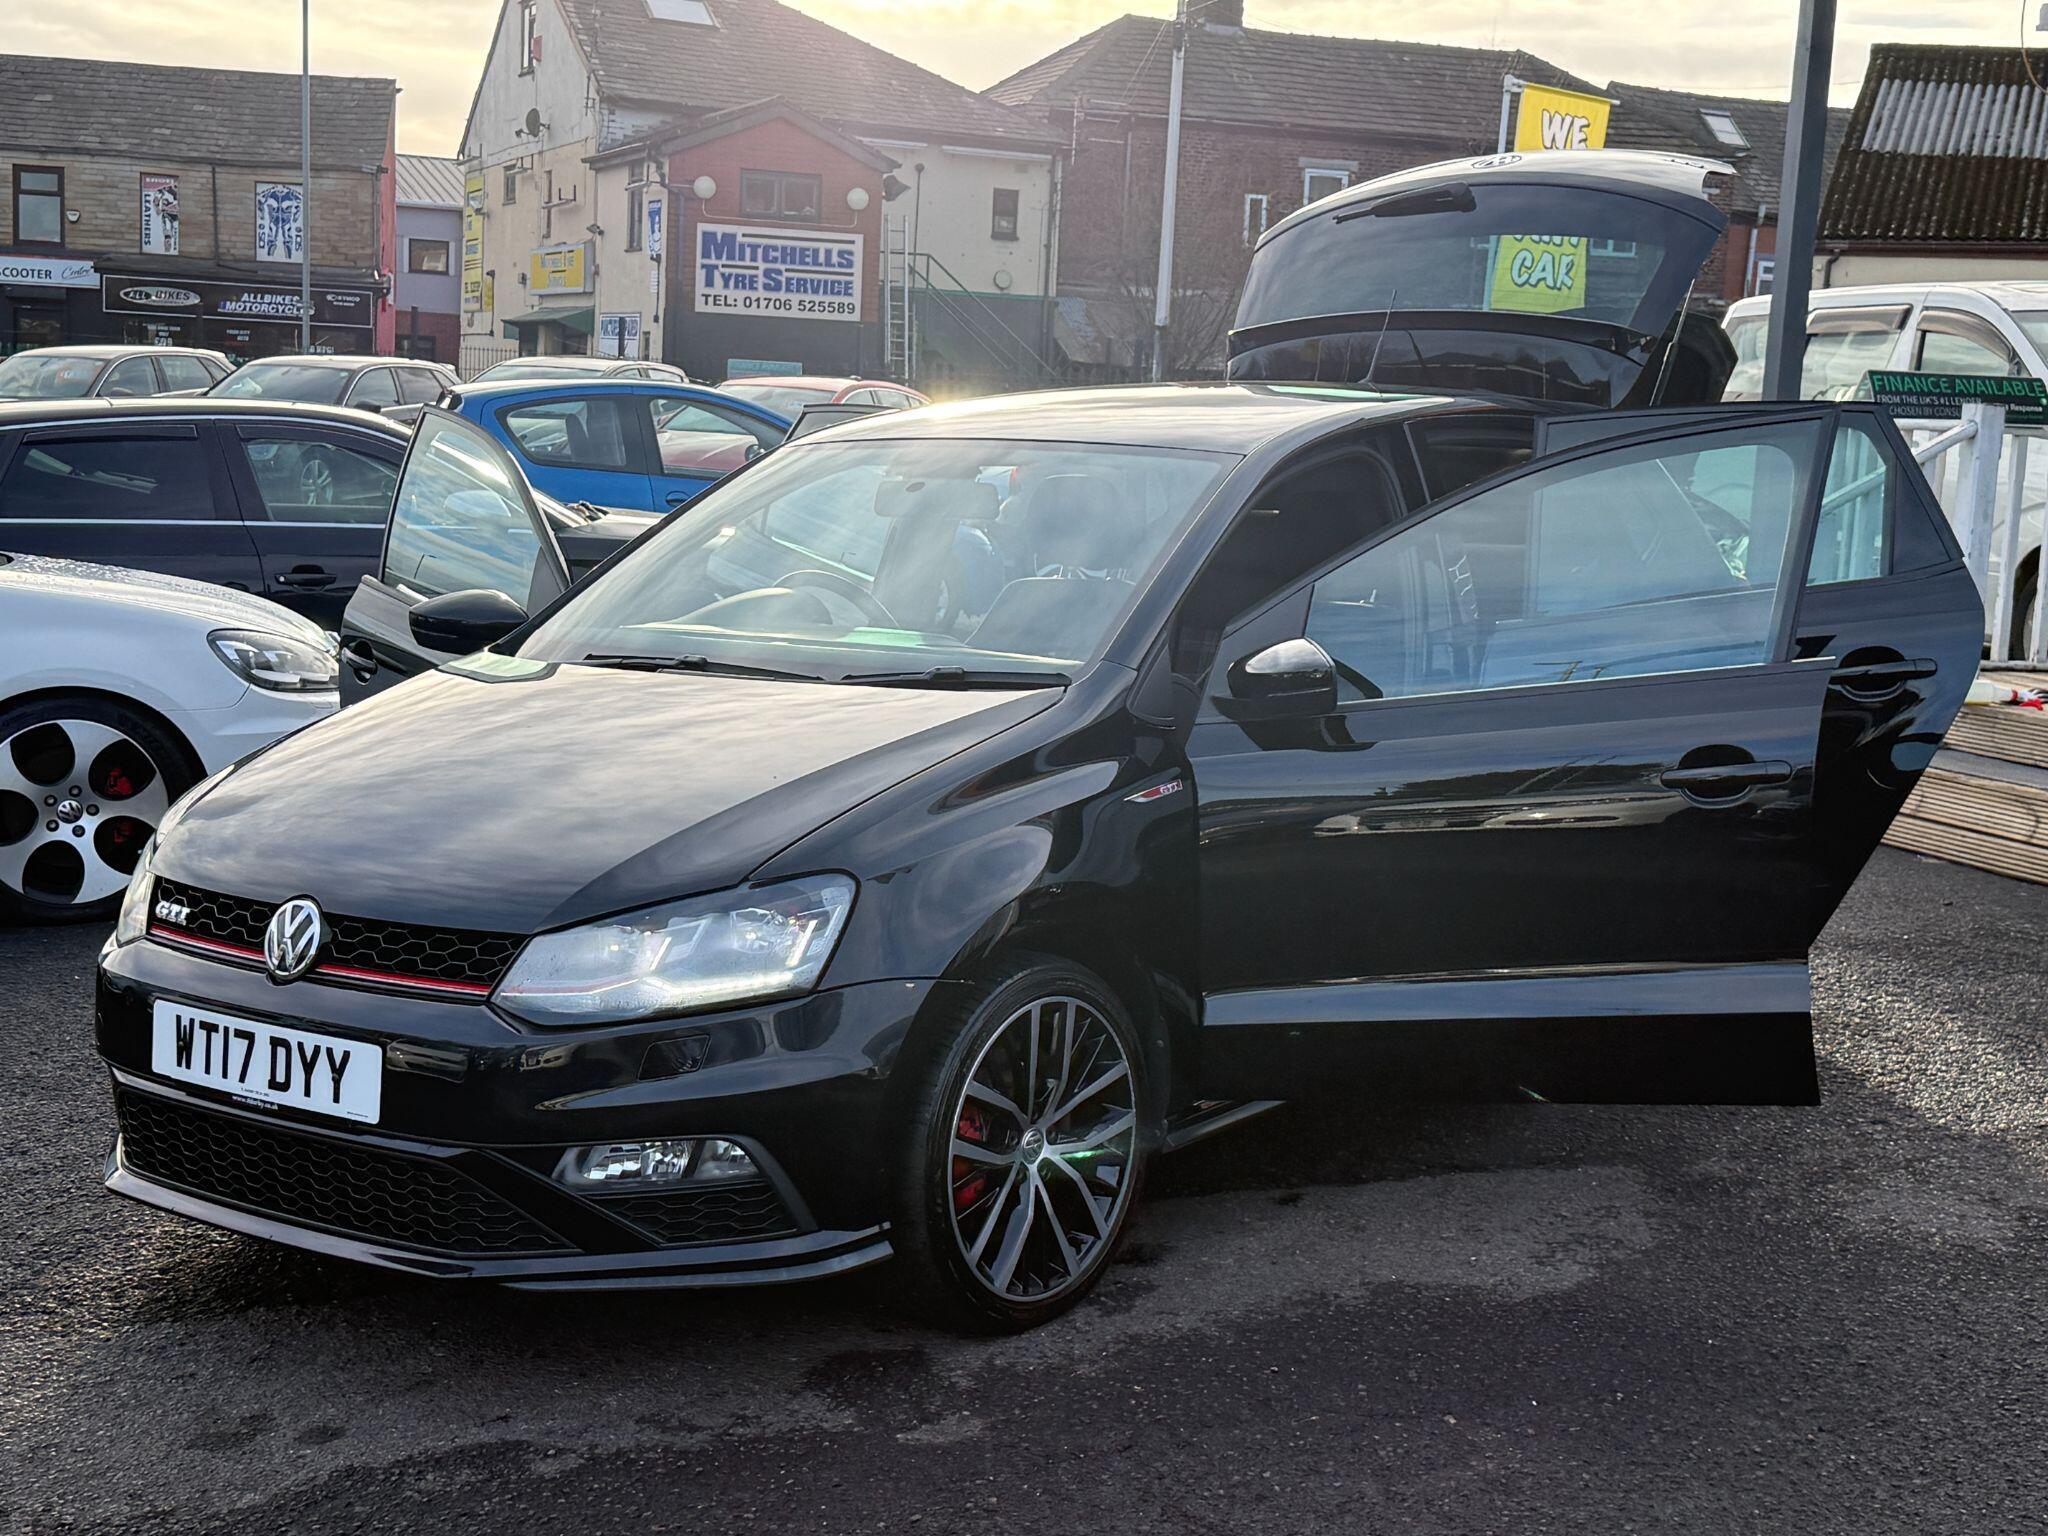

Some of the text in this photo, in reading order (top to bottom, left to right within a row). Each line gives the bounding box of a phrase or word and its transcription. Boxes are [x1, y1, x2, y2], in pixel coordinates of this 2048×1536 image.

[1541, 108, 1591, 149] WE
[701, 231, 855, 269] MITCHELLS
[0, 266, 52, 280] COOTER
[700, 263, 854, 297] TYRE SERVICE
[1511, 248, 1575, 291] CAR
[155, 290, 191, 301] BIKES
[241, 293, 301, 306] ALLBIKES
[702, 294, 856, 315] TEL: 01706 525589
[1872, 375, 2045, 397] FINANCE AVAILABLE
[1901, 395, 1919, 404] THE
[1889, 406, 1921, 416] CHOSEN
[1922, 407, 1933, 416] BY
[155, 900, 191, 926] GTI
[175, 1014, 351, 1104] WT17 DYY
